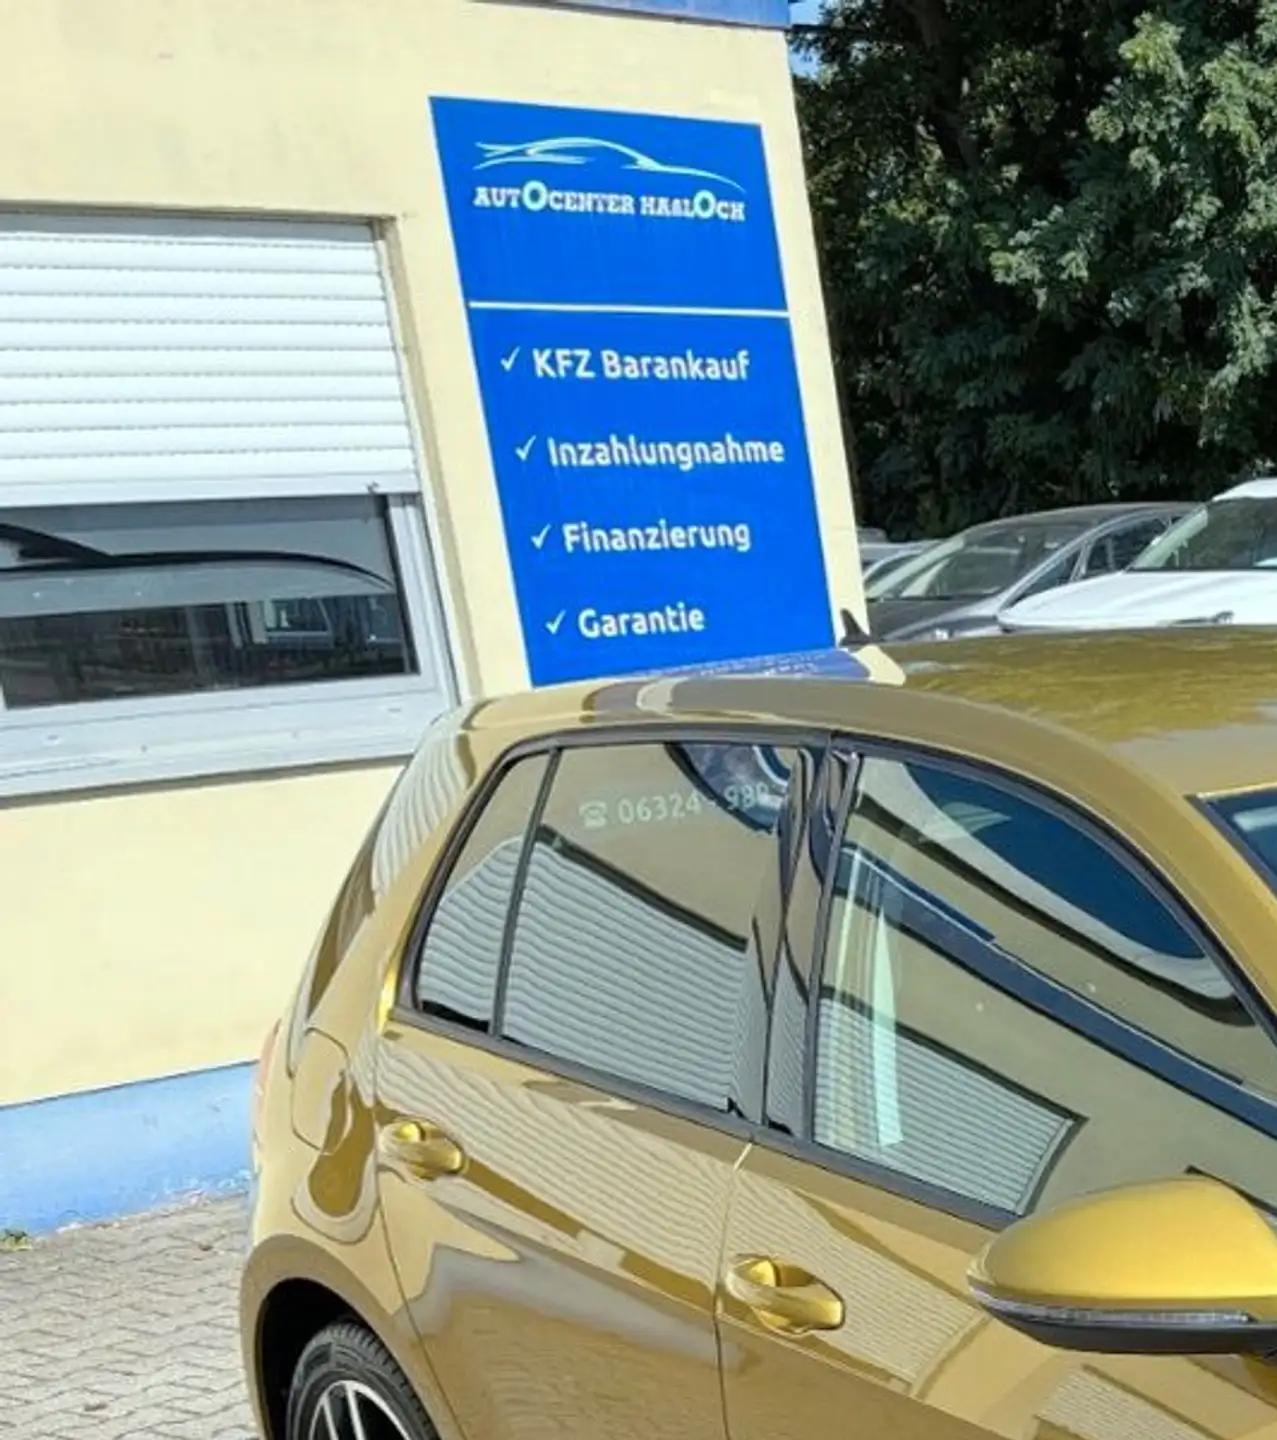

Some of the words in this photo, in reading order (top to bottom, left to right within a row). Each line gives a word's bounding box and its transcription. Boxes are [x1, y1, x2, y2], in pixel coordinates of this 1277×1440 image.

[472, 180, 636, 214] AUTOCENTER
[532, 347, 596, 379] KFZ
[600, 348, 750, 381] Barankauf
[546, 432, 785, 471] Inzahlungnahme
[561, 518, 751, 553] Finanzierung
[577, 601, 706, 639] Garantie
[617, 789, 702, 825] 06324
